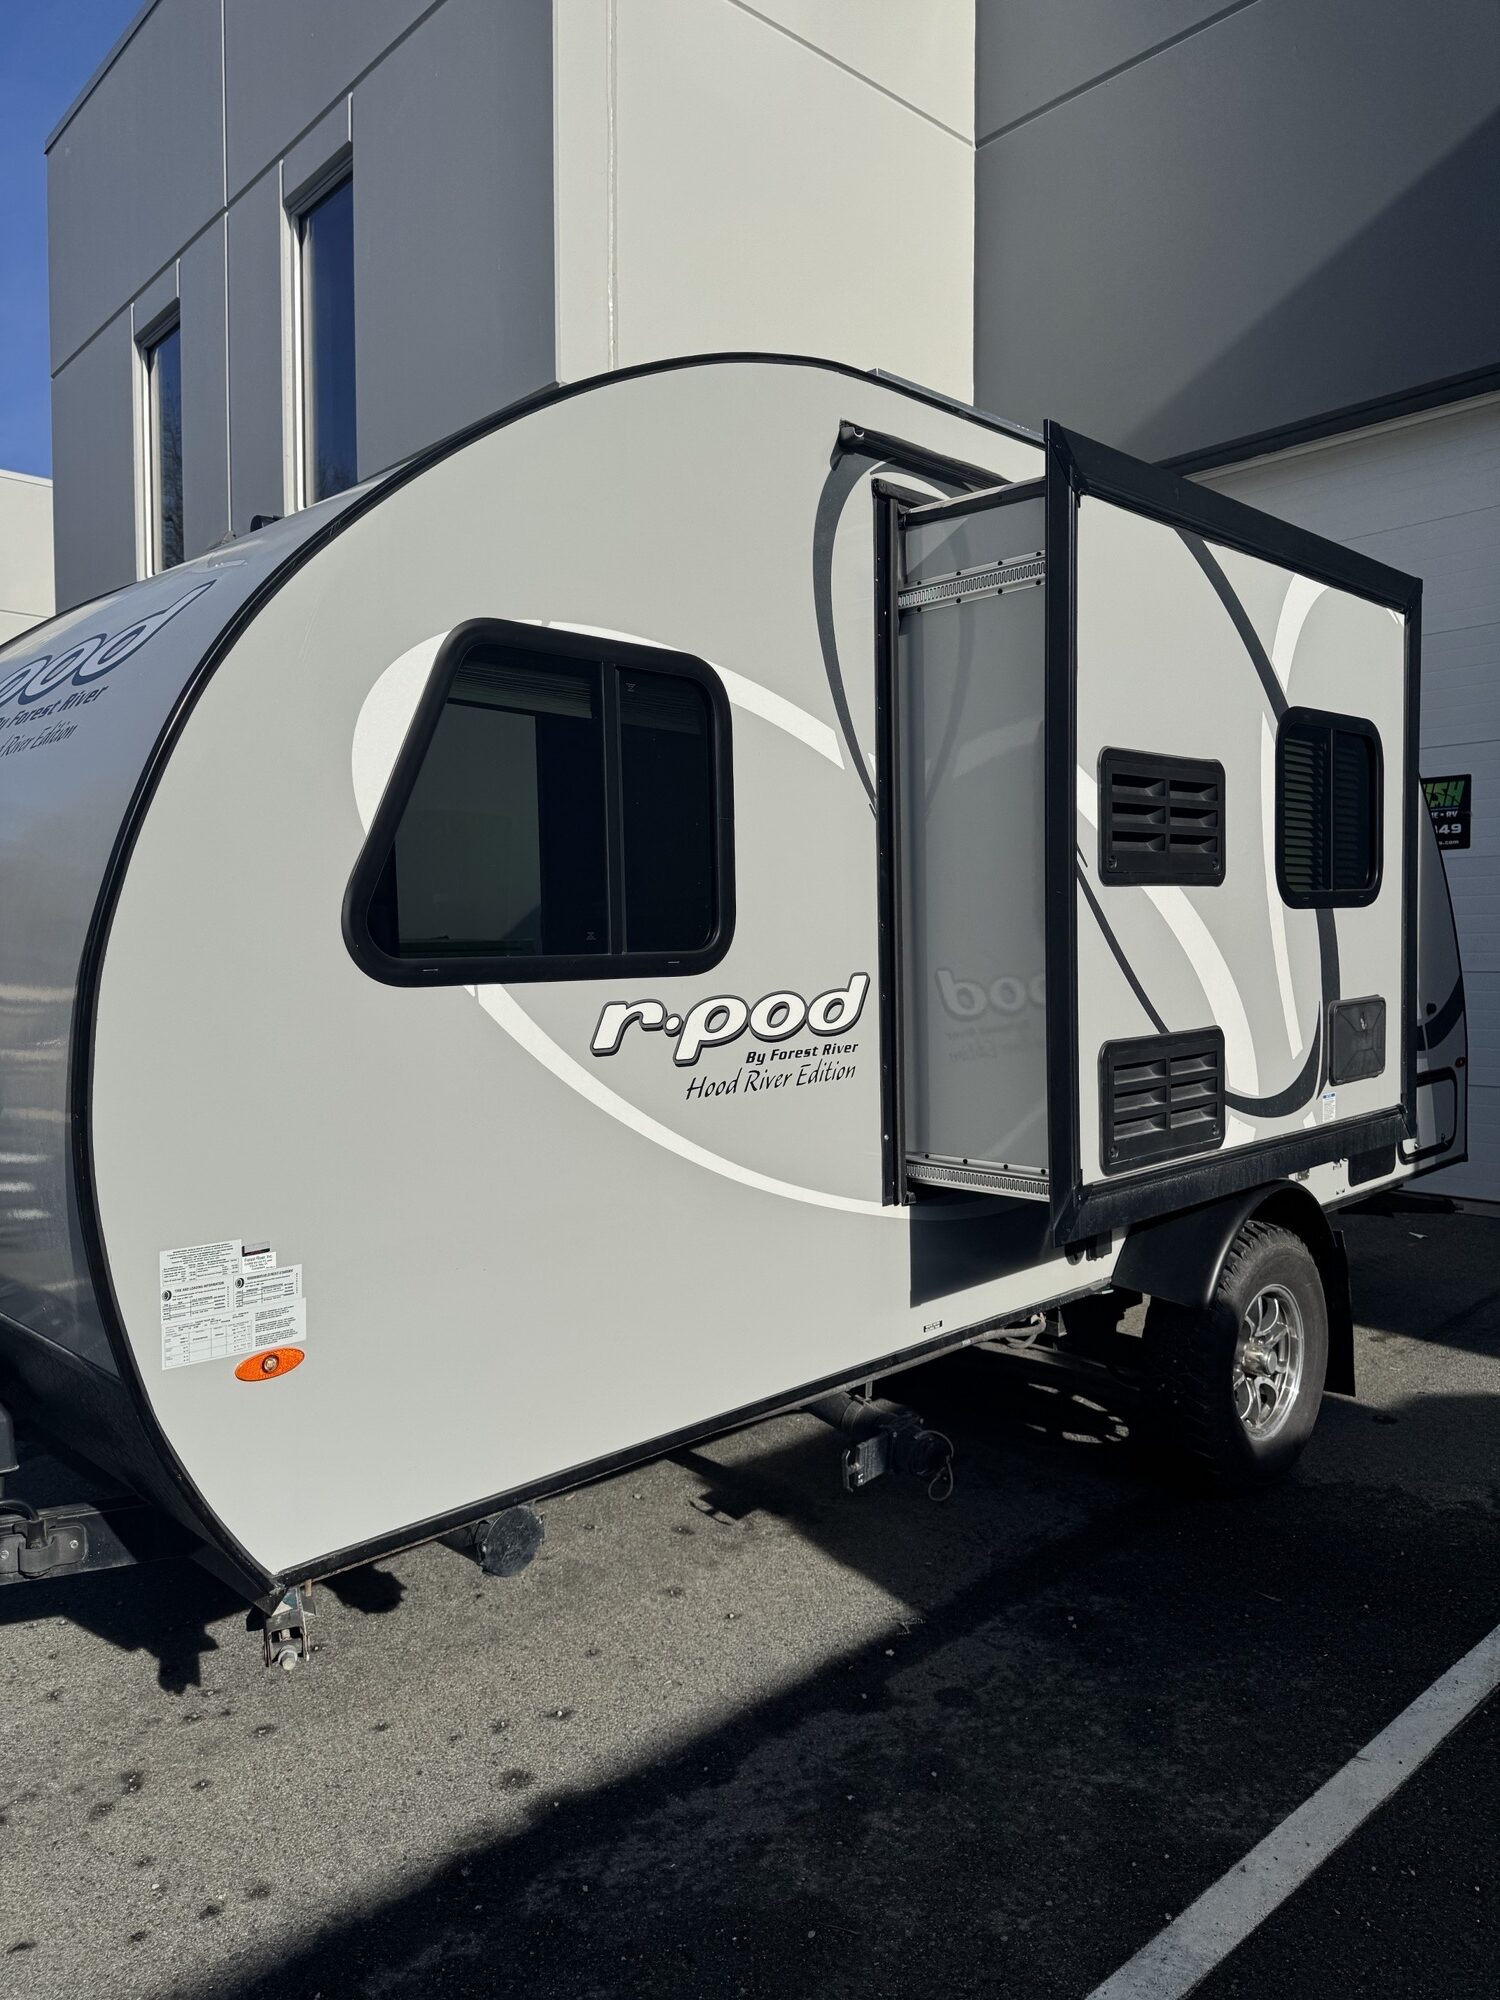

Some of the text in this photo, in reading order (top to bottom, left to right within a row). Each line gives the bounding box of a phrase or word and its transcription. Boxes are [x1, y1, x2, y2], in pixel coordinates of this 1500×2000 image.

[6, 699, 62, 728] Forest
[57, 685, 109, 712] River
[30, 719, 78, 750] Edition
[1435, 823, 1462, 835] 49
[745, 1042, 859, 1067] By Forest River
[685, 1057, 856, 1100] Hood River Edition
